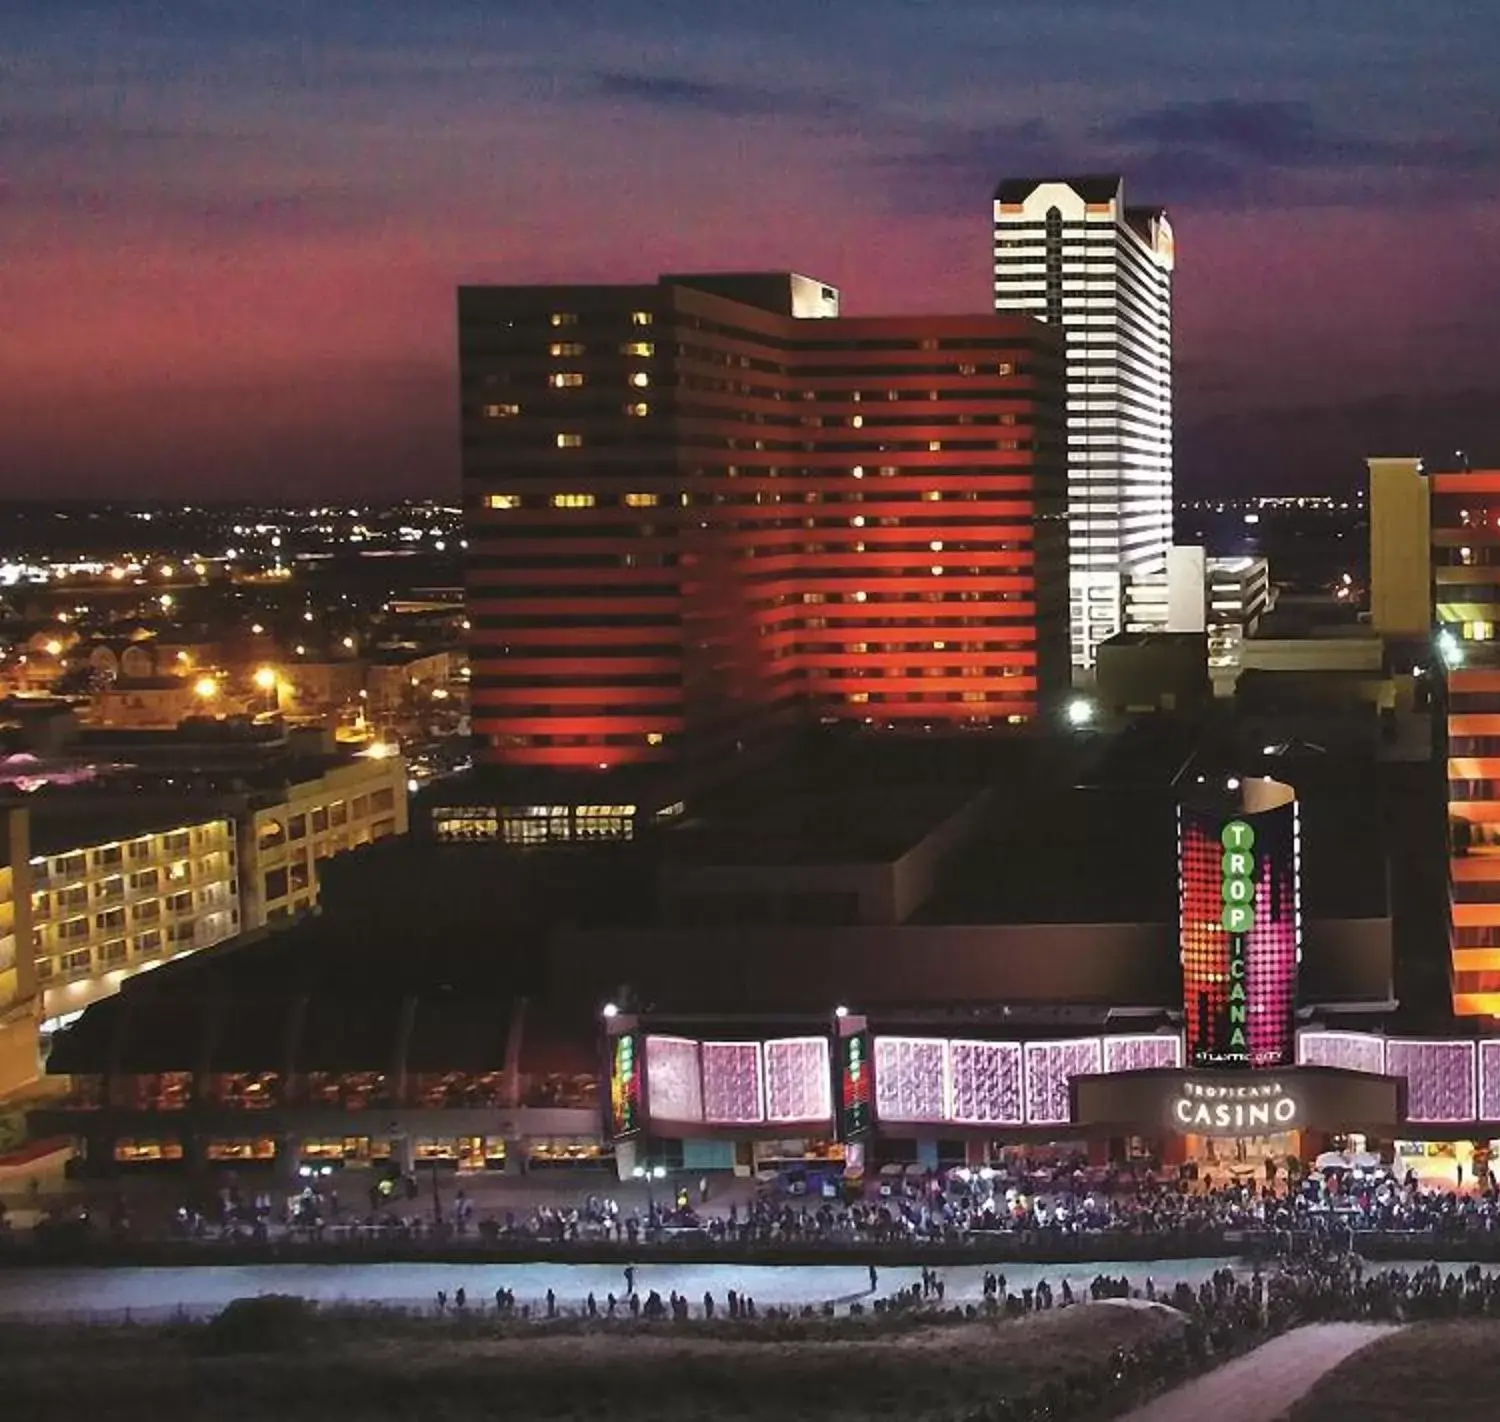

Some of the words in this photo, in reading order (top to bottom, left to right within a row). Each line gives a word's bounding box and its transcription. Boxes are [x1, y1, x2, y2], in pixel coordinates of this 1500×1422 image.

[1229, 825, 1247, 1046] TROPICANA
[1184, 1082, 1283, 1098] TROPICANA
[1177, 1098, 1296, 1127] CASINO
